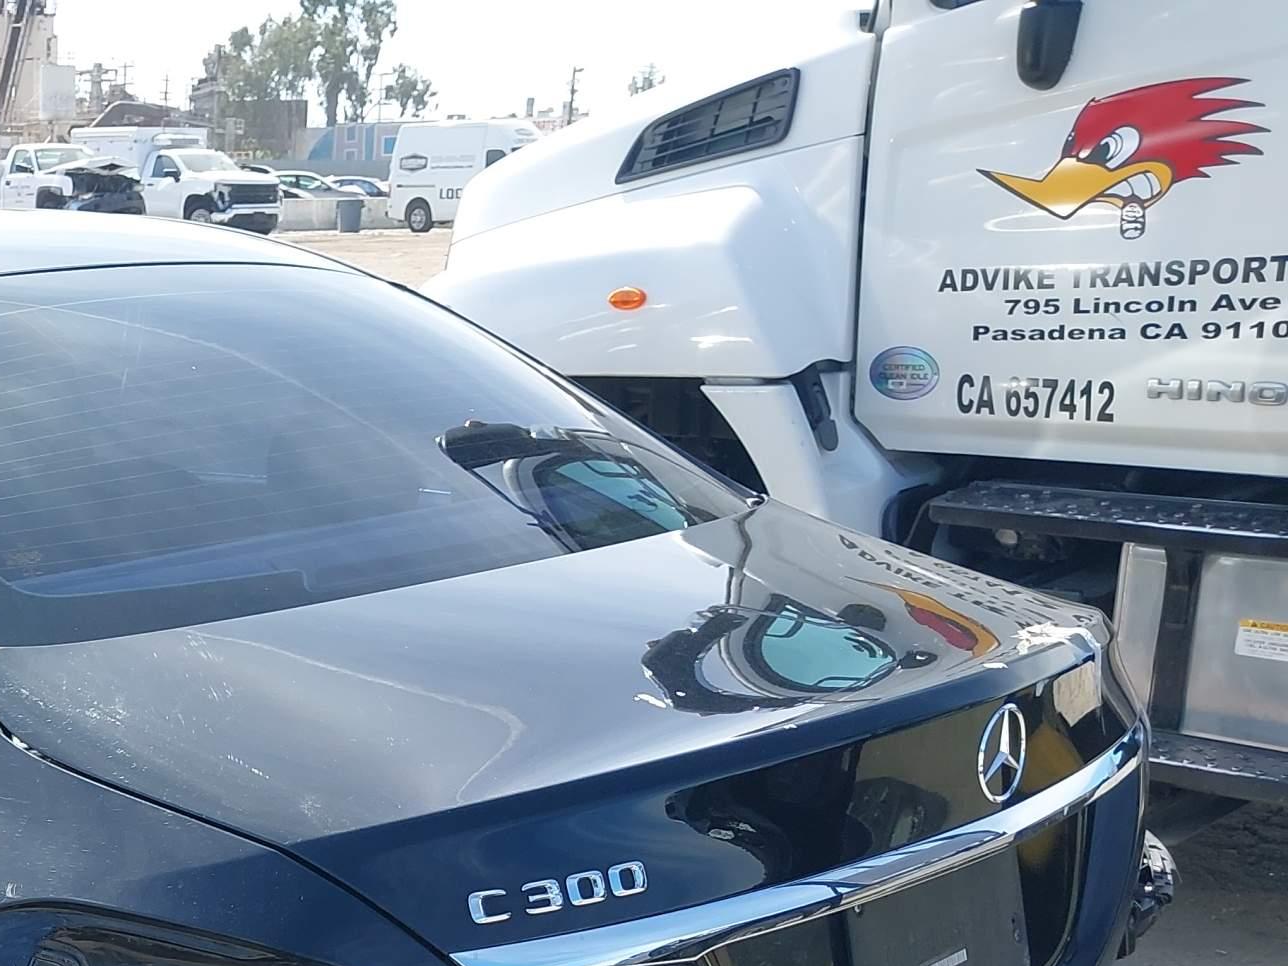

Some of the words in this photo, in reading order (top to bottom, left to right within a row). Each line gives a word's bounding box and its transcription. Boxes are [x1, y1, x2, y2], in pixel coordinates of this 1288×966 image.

[938, 264, 1056, 293] ADVIKE
[1005, 298, 1060, 316] 795
[1073, 295, 1197, 314] Lincoln
[1210, 293, 1282, 312] Ave
[972, 324, 1127, 342] Pasadena
[1140, 322, 1189, 340] CA
[956, 373, 996, 416] CA
[1004, 375, 1115, 424] 657412
[1146, 377, 1288, 408] HINO
[467, 888, 513, 925] C
[520, 860, 649, 916] 300
